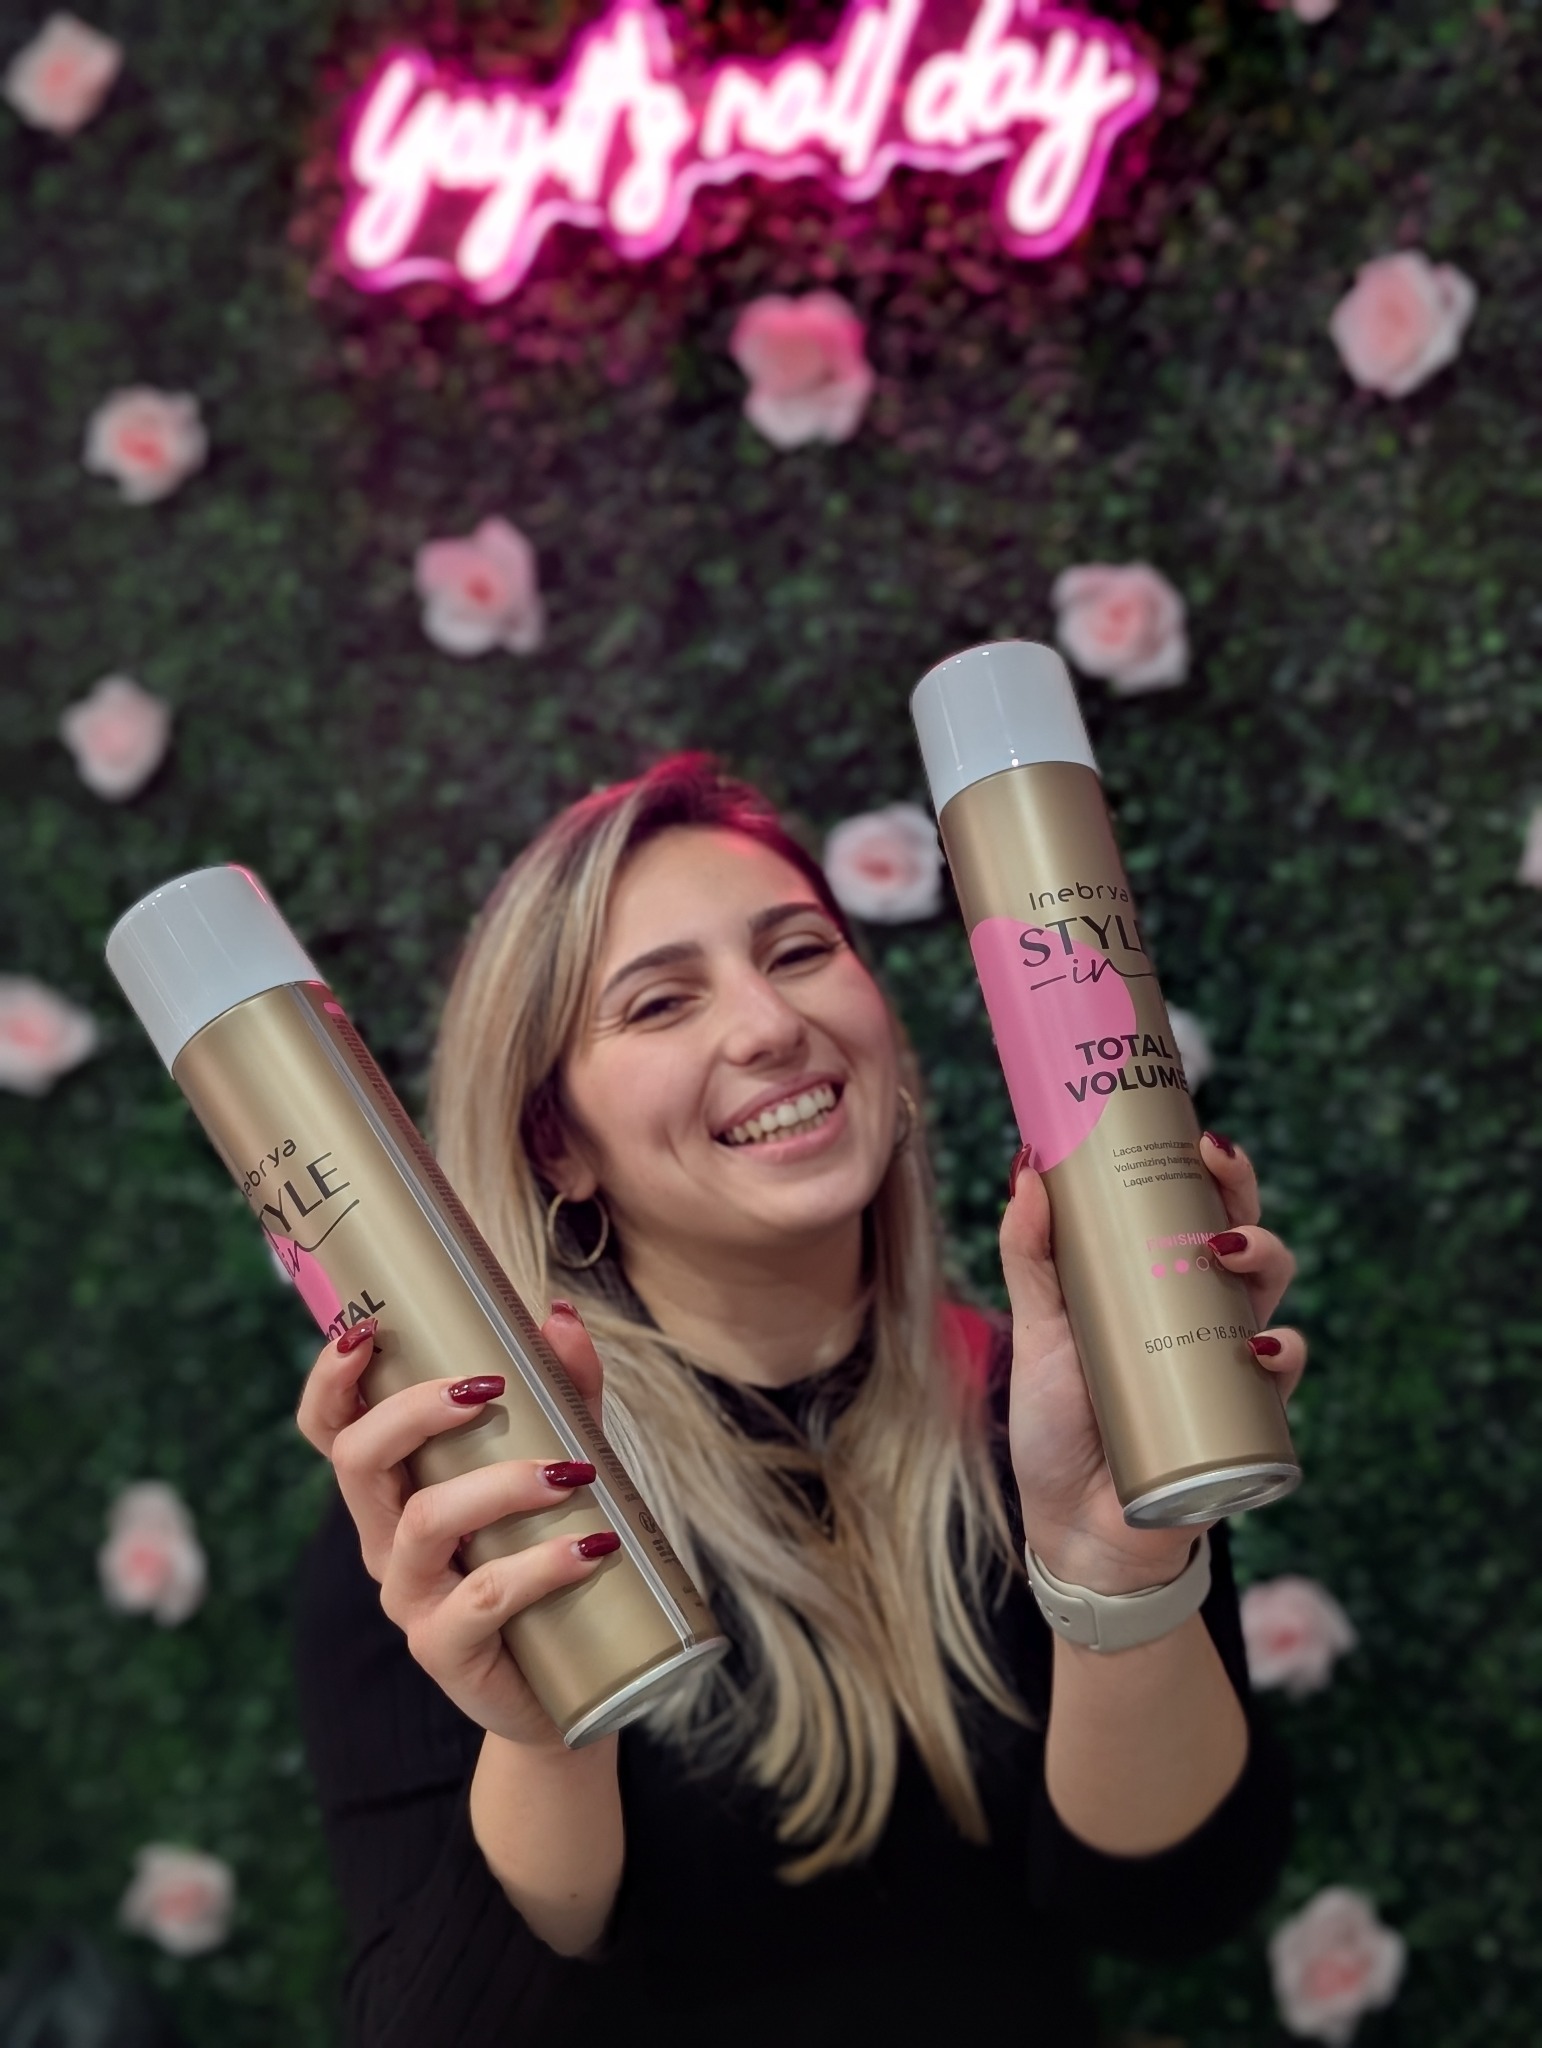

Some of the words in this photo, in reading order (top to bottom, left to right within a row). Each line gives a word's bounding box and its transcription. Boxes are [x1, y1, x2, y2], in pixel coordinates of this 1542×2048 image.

[904, 0, 1138, 236] day
[1028, 881, 1130, 911] Inebrya
[1074, 1033, 1174, 1066] TOTAL
[1064, 1064, 1189, 1103] VOLUME
[1112, 1145, 1143, 1158] Lacca
[1113, 1157, 1167, 1173] Volumizing
[241, 1138, 297, 1198] ebrya
[1122, 1175, 1154, 1188] Laque
[326, 1289, 387, 1342] OTAL
[1144, 1335, 1174, 1354] 500
[1176, 1330, 1195, 1346] ml
[1212, 1325, 1238, 1340] 16.9
